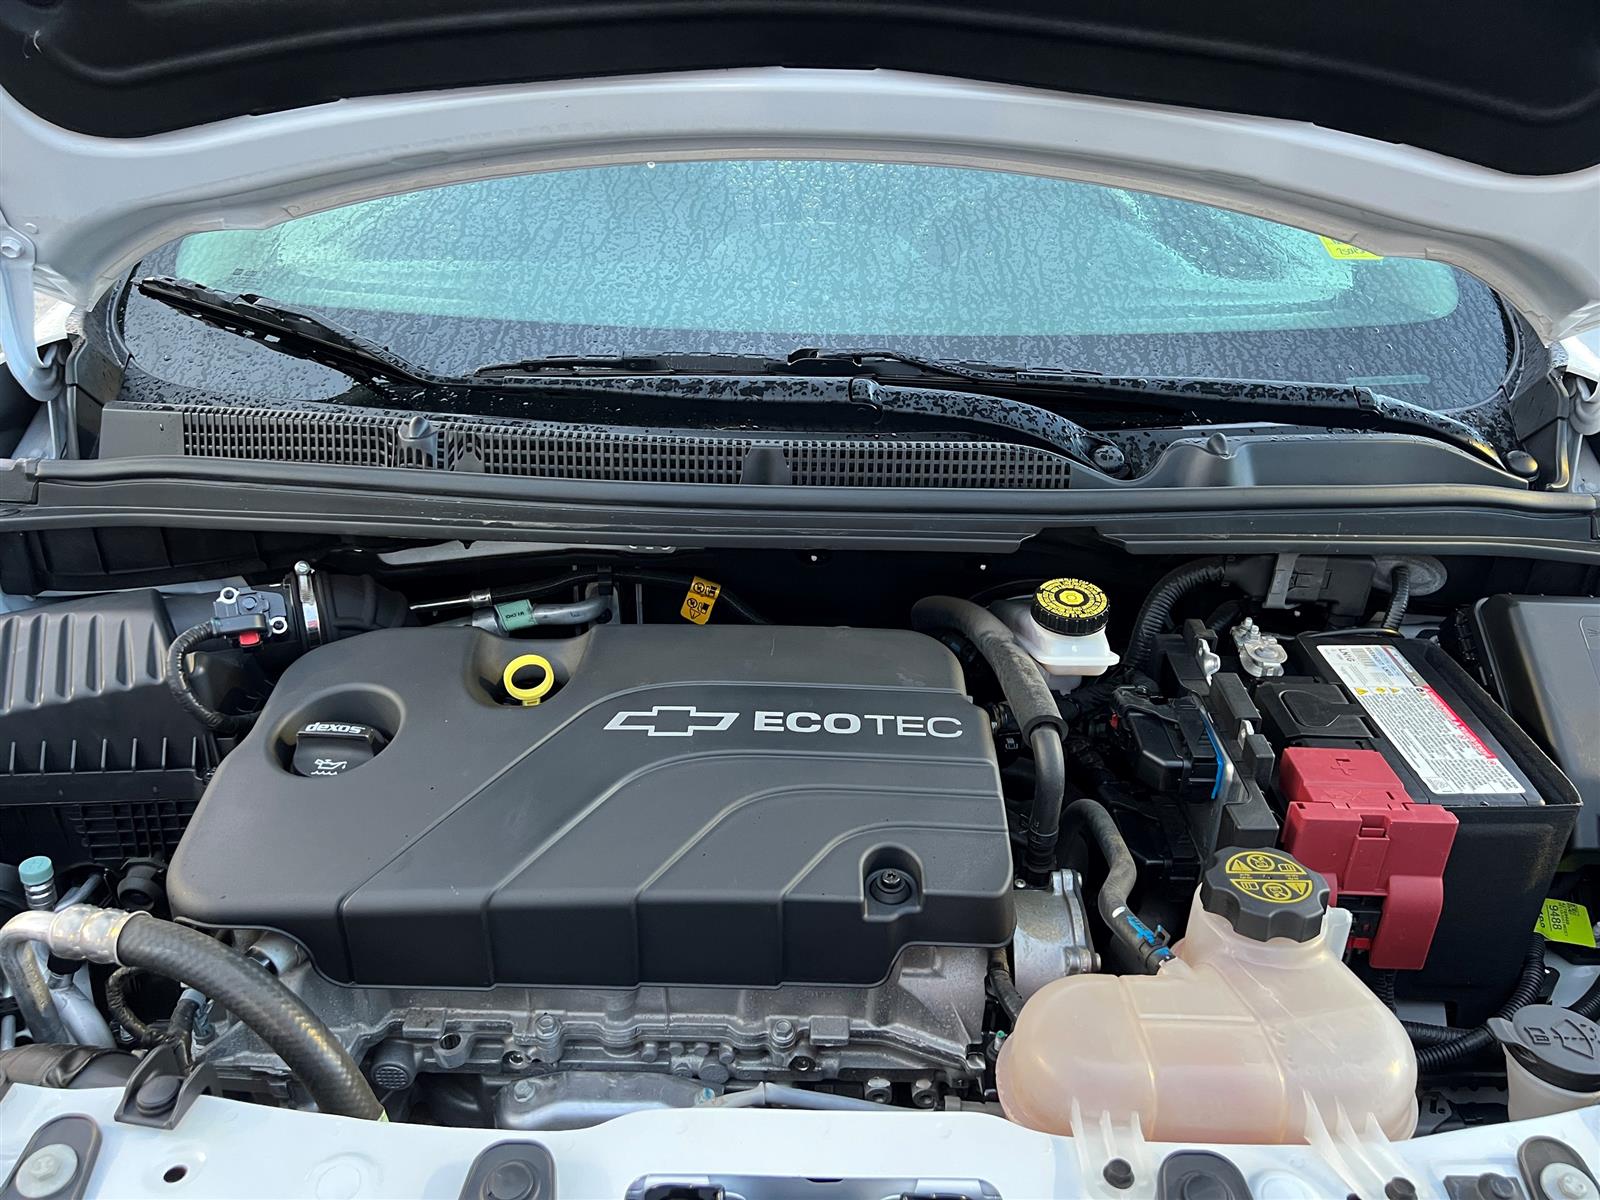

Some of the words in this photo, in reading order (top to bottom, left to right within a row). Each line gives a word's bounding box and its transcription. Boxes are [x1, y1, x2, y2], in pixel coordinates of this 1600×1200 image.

[305, 722, 362, 734] dexos
[754, 711, 963, 738] ECOTEC
[1549, 905, 1563, 930] 9488
